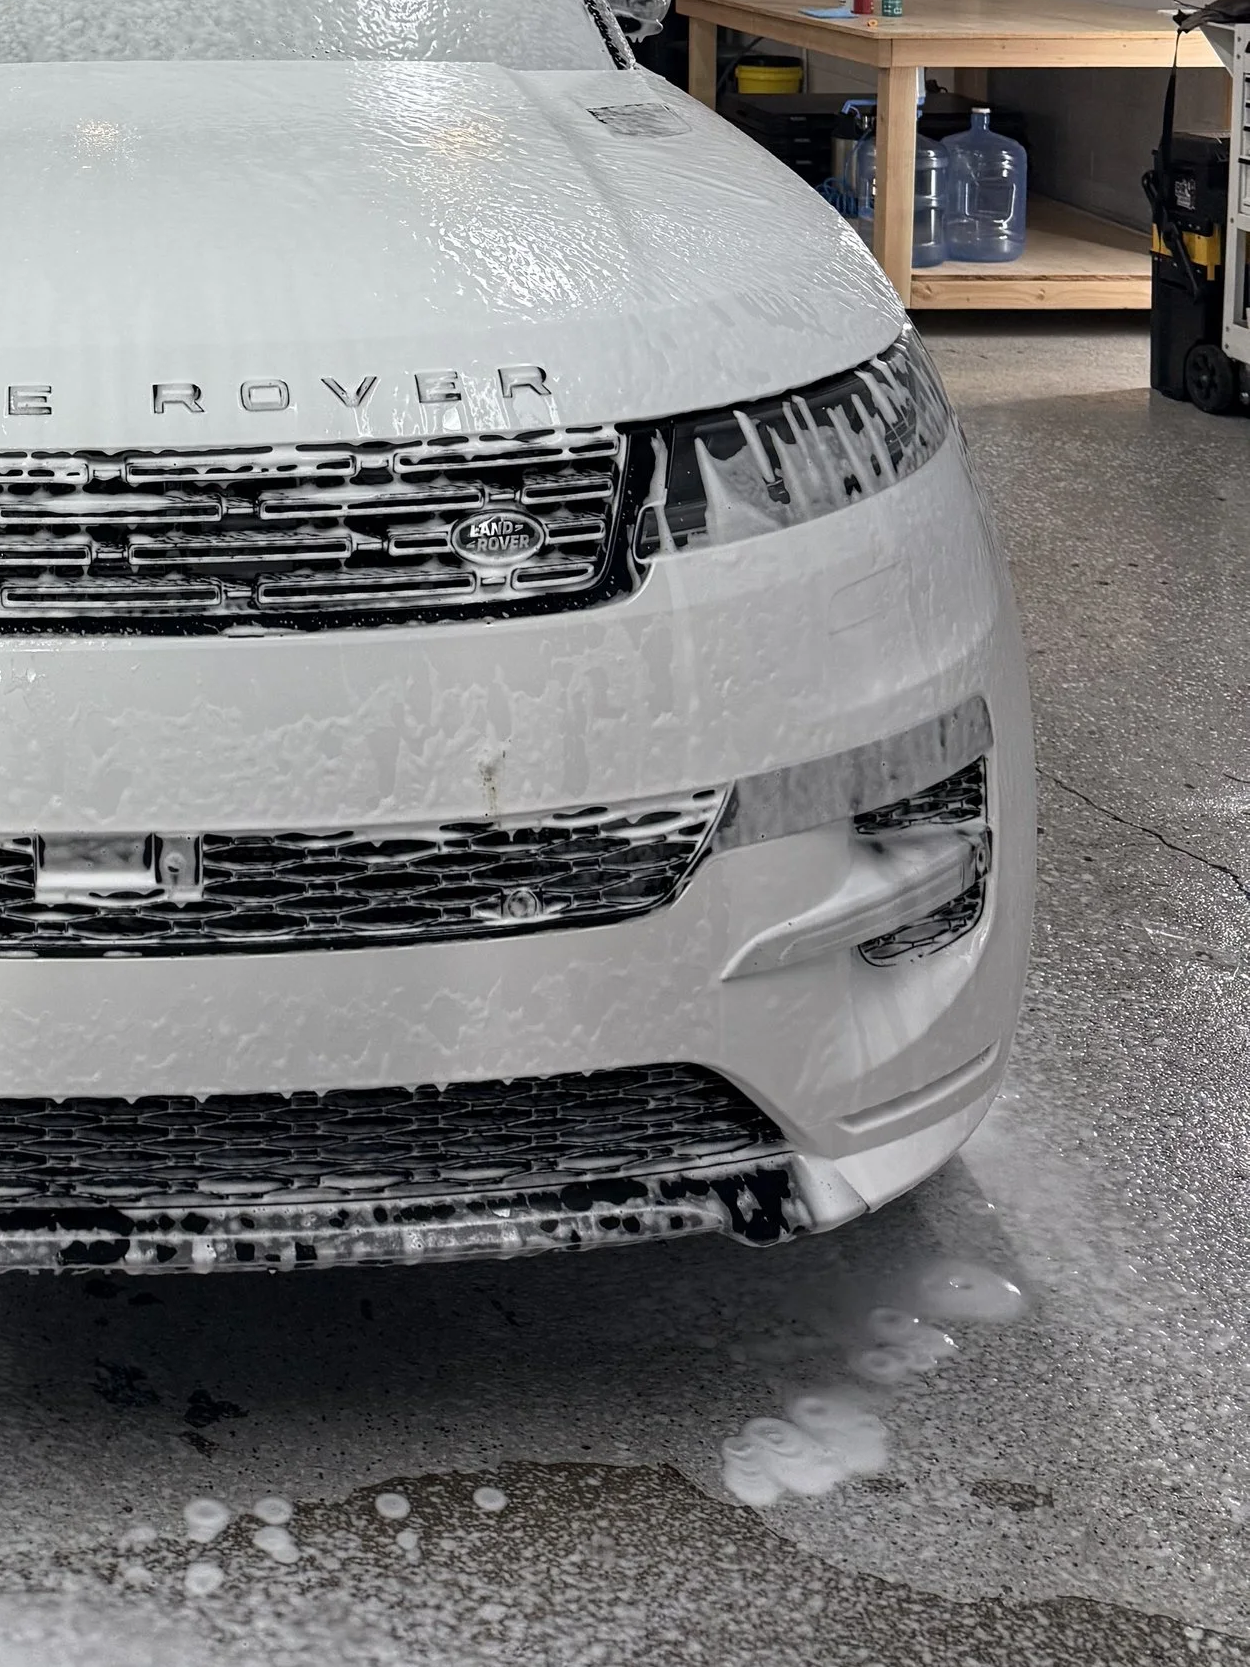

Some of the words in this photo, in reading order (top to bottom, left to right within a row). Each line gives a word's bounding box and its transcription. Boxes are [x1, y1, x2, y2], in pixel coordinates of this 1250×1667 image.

[152, 365, 552, 415] ROVER
[469, 521, 514, 538] LAND
[476, 534, 530, 552] ROVER
